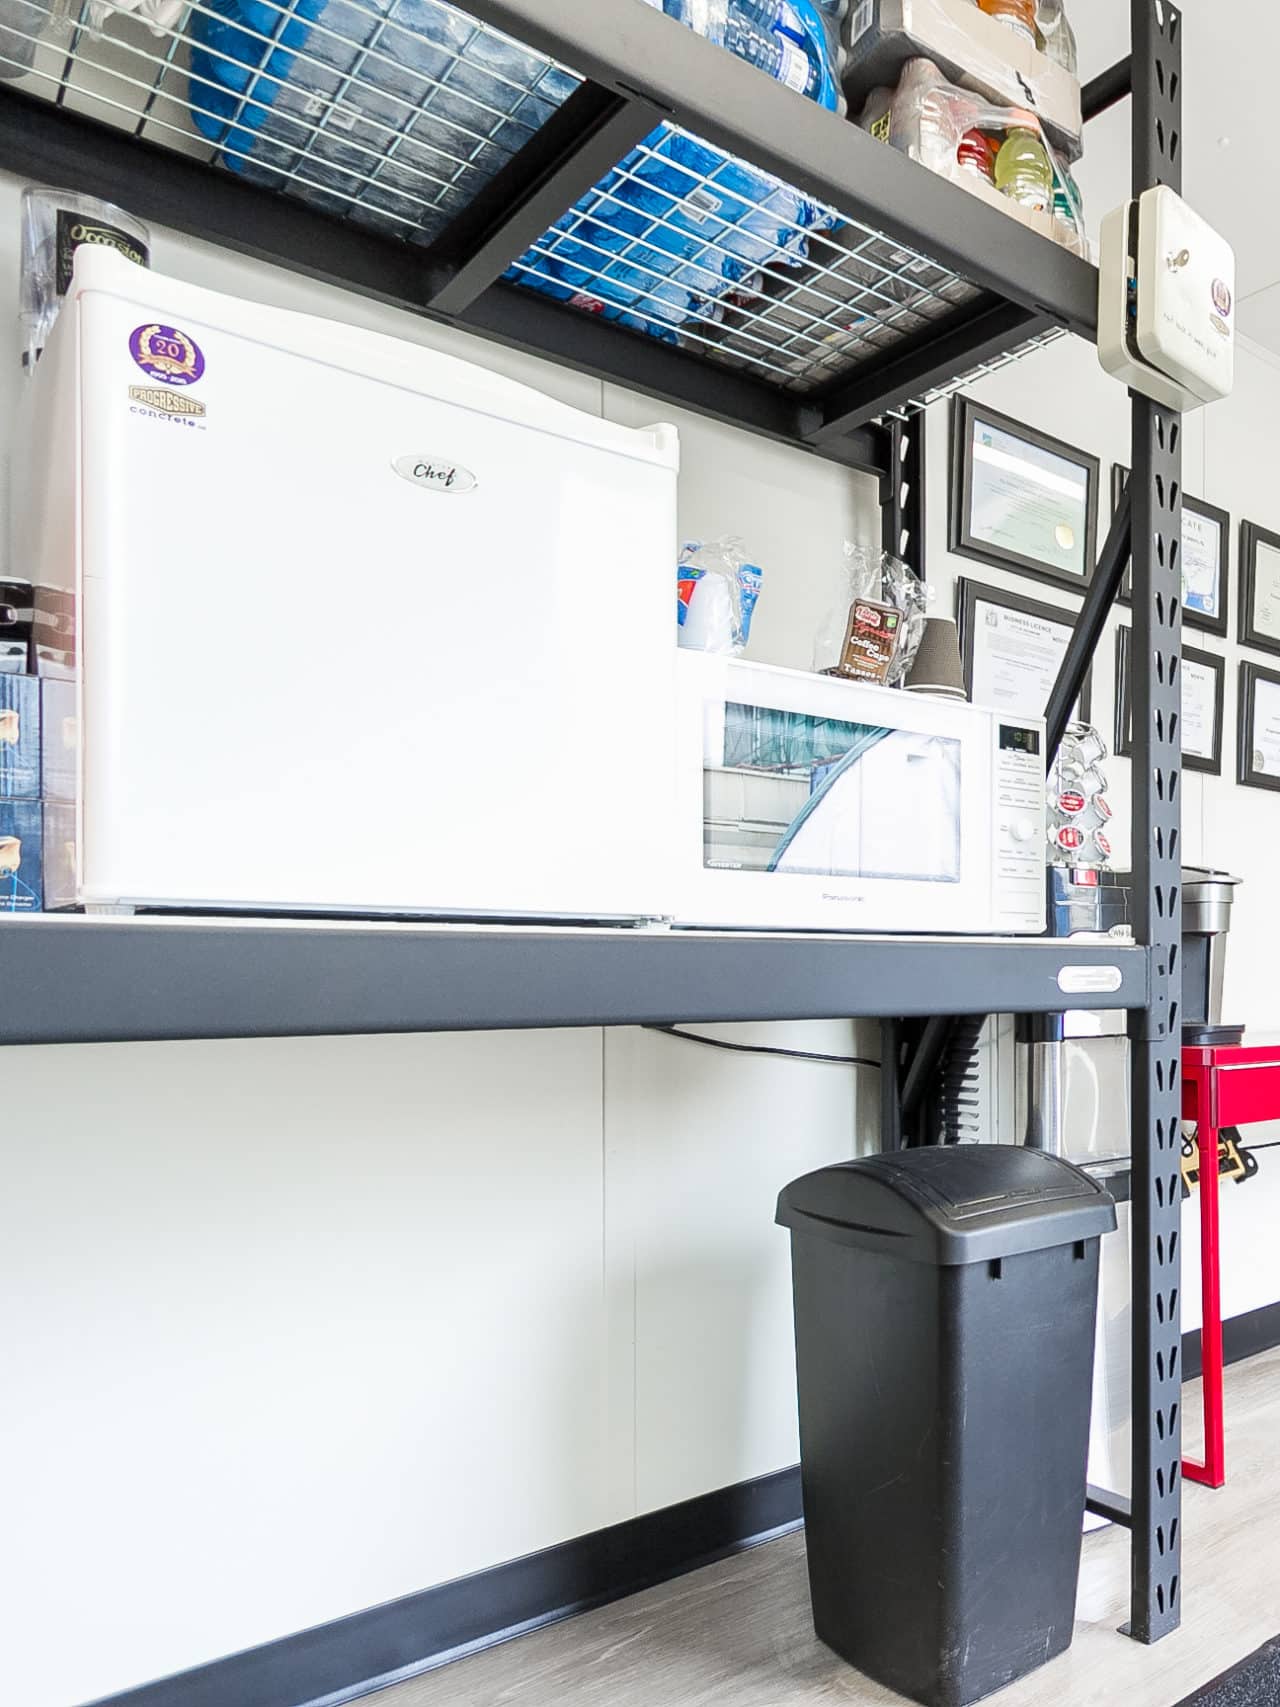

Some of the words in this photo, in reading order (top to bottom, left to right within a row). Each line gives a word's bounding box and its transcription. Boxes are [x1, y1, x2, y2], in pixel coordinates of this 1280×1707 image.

[156, 340, 180, 357] 20
[131, 387, 203, 414] PROGRESSIVE
[129, 405, 196, 427] concrete
[413, 463, 456, 487] Chef
[850, 635, 880, 652] Coffee
[866, 649, 890, 662] Cups
